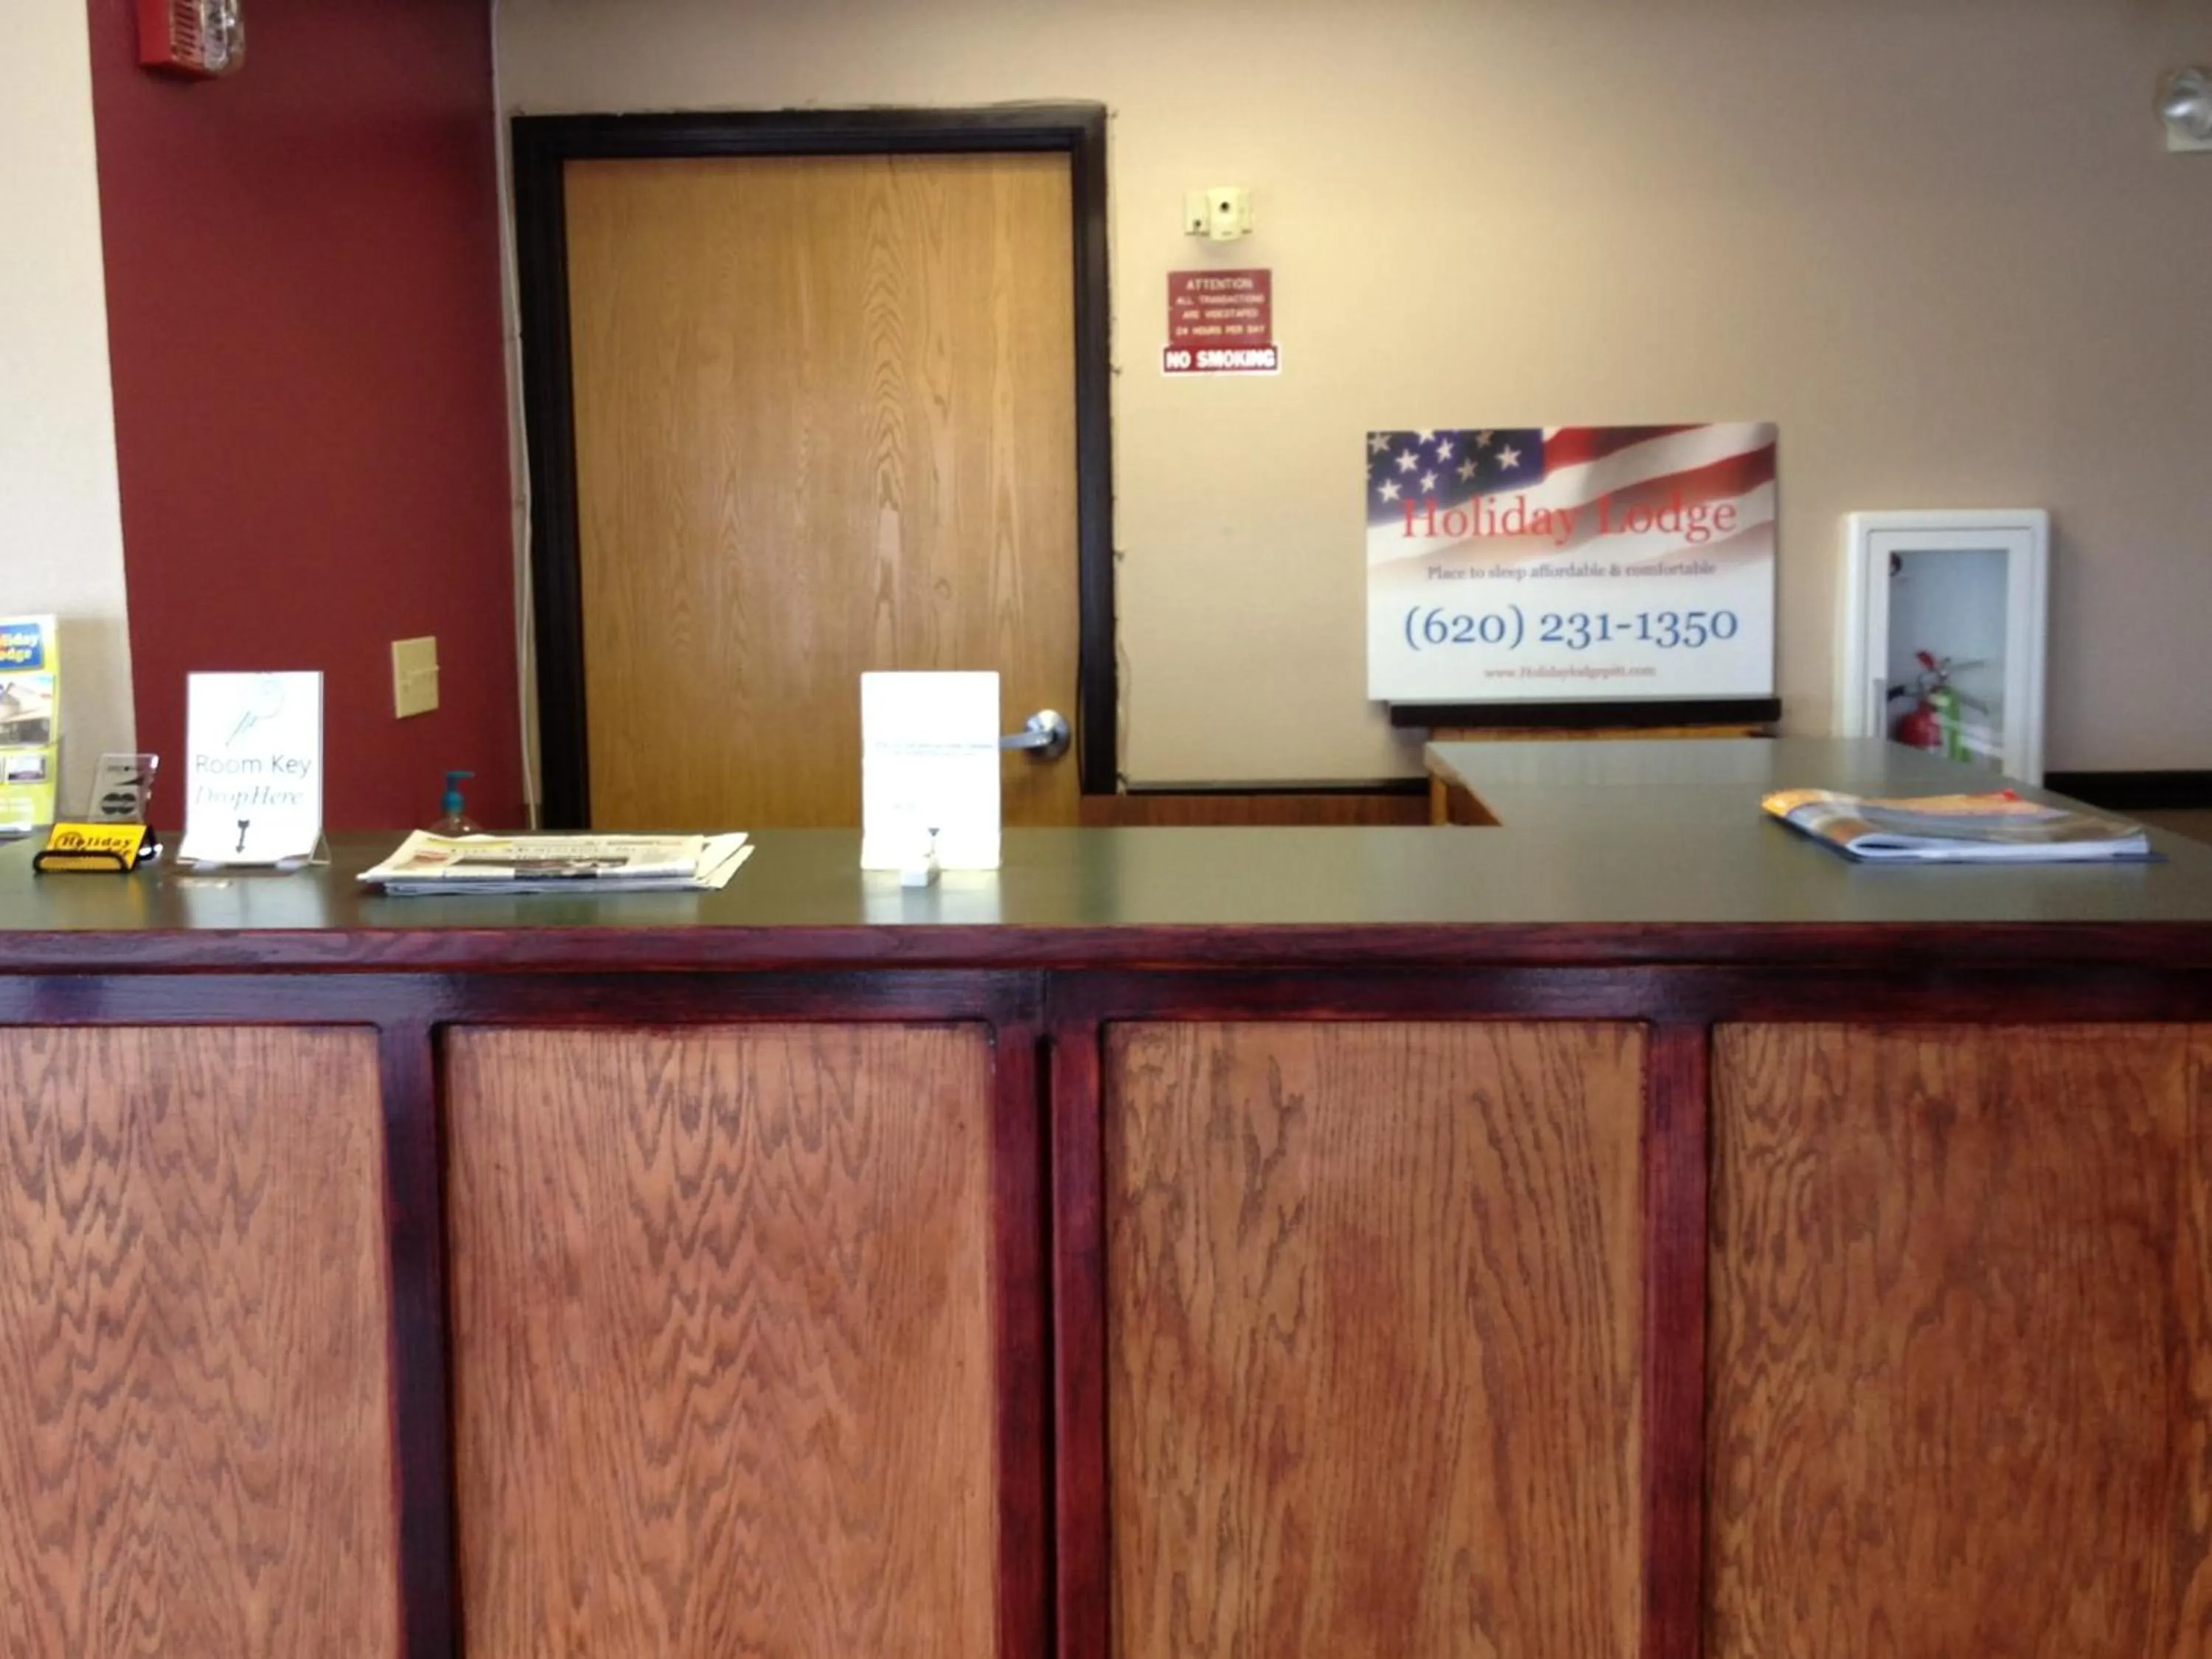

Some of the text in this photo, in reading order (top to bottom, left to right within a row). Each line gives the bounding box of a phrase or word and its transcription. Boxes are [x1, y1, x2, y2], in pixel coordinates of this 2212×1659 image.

[1186, 278, 1253, 291] ATTENTION
[1166, 349, 1276, 369] NO SMOKING
[1402, 493, 1738, 546] Holiday Lodge
[1427, 560, 1717, 582] Place to sleep affordable & comfortable
[1405, 605, 1739, 652] (620) 231-1350
[195, 754, 312, 779] Room Key
[251, 785, 303, 805] Here
[62, 835, 133, 849] Holiday
